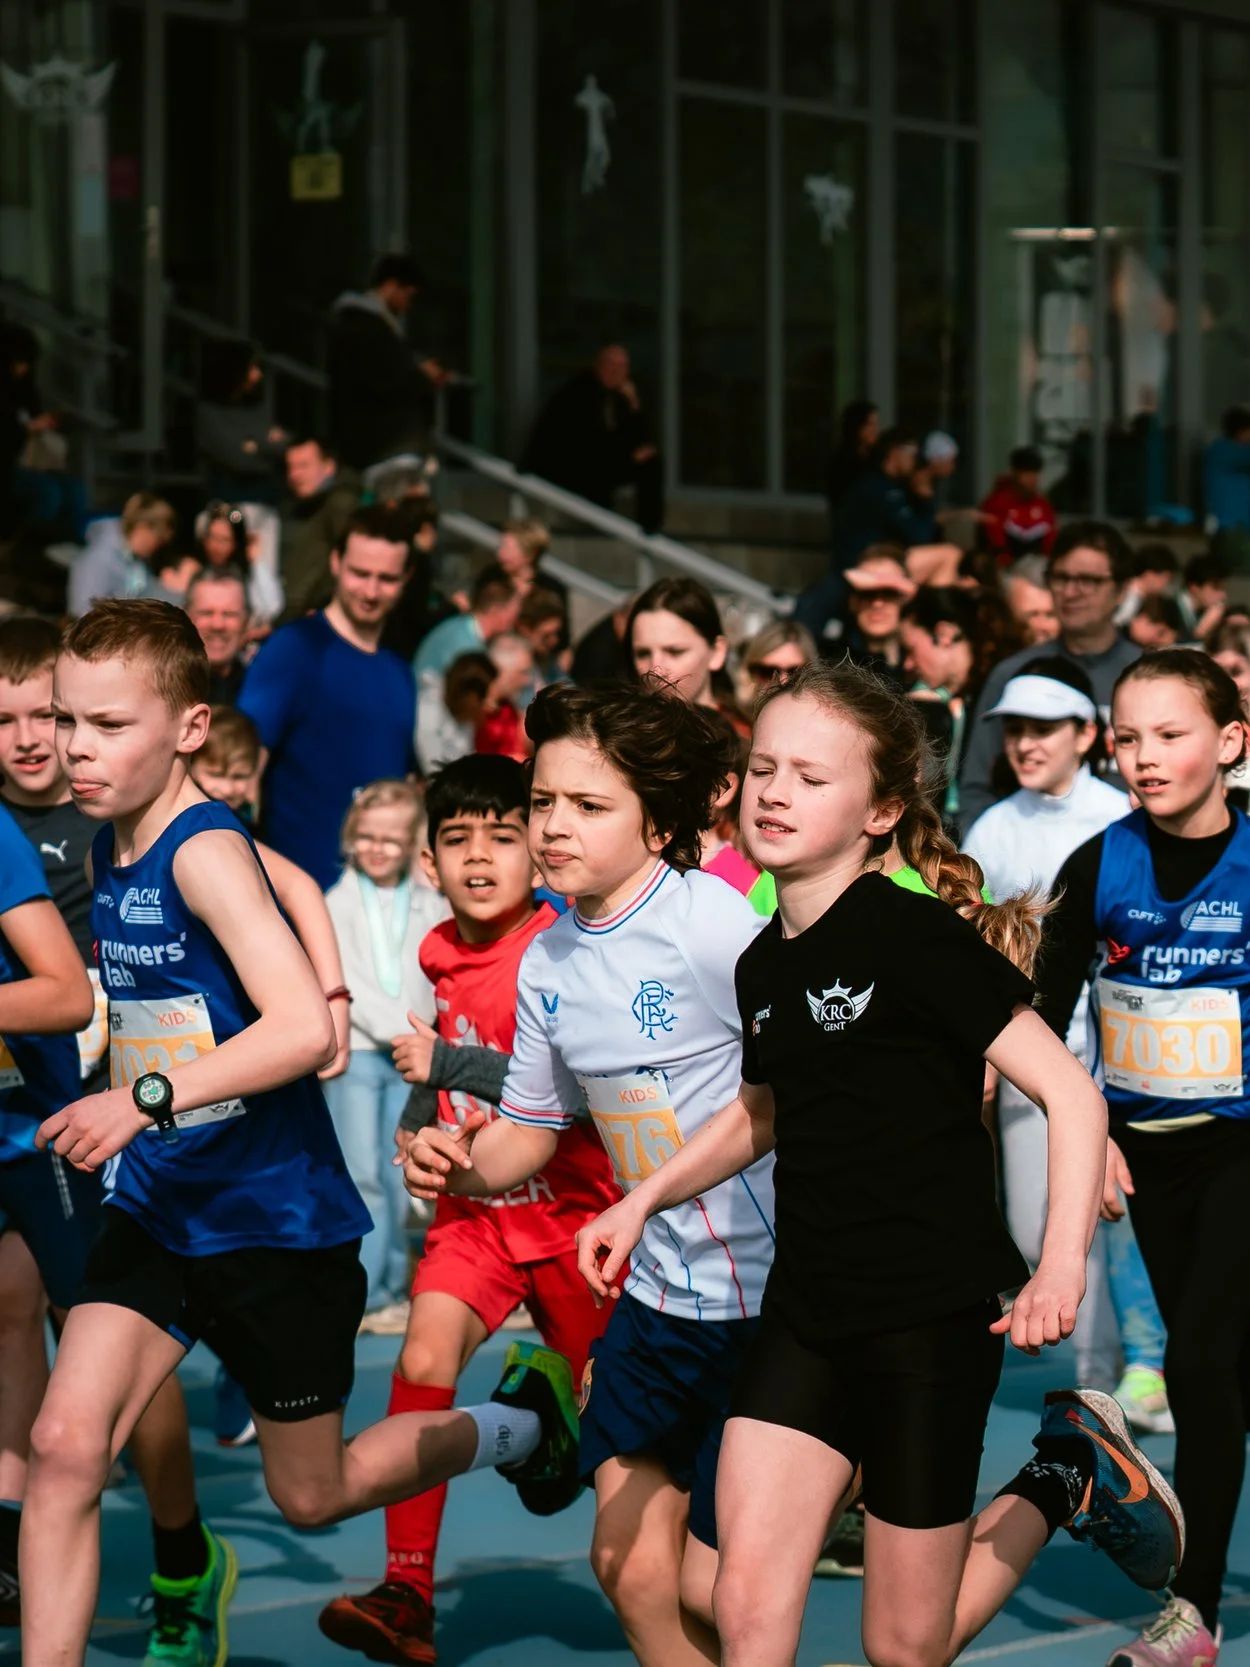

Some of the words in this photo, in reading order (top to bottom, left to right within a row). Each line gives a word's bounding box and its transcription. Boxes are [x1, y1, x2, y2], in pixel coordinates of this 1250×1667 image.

[132, 888, 161, 905] ACHL
[1196, 901, 1244, 916] ACHL
[102, 932, 186, 966] runners'
[104, 960, 136, 987] lab
[1141, 961, 1182, 983] lab
[820, 1003, 851, 1021] KRC
[1191, 997, 1230, 1010] KIDS
[157, 1007, 198, 1027] KIDS
[1106, 1015, 1231, 1075] 7030
[619, 1086, 657, 1103] KIDS
[275, 1395, 319, 1408] KIPSTA
